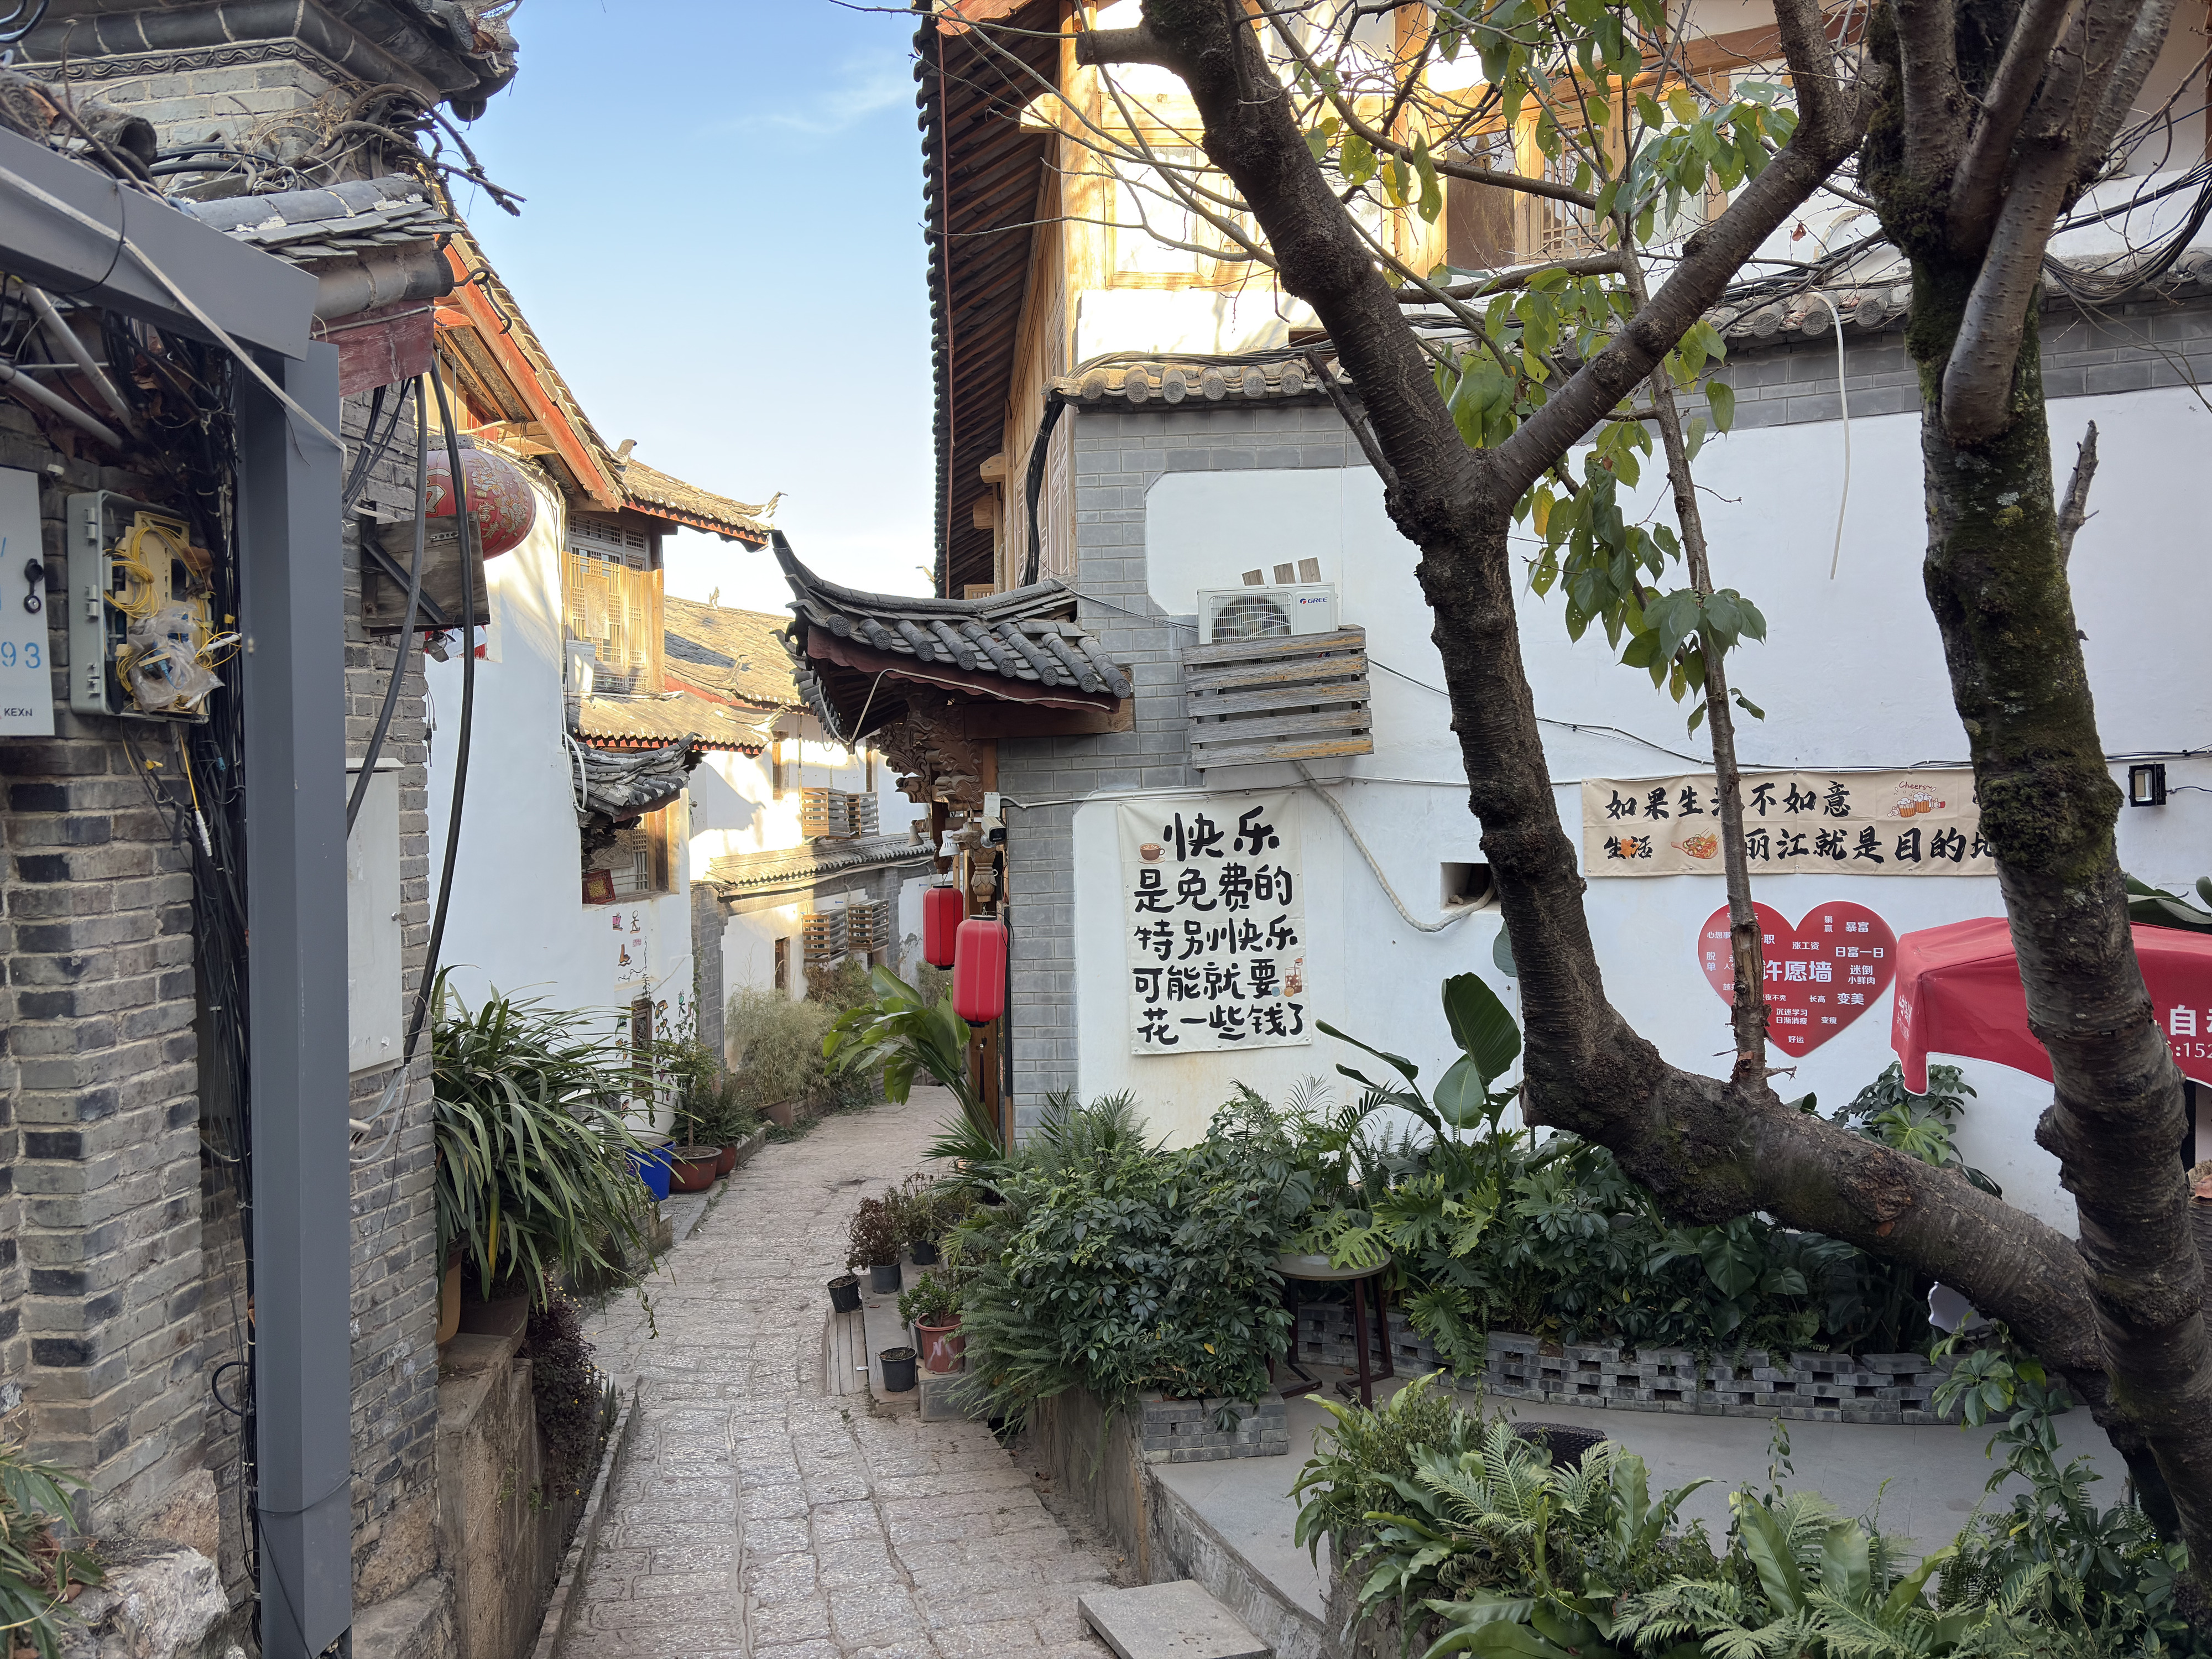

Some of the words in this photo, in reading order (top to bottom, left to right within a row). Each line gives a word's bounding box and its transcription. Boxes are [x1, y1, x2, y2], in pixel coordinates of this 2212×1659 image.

[1, 641, 41, 670] 93
[1163, 805, 1280, 862] 快乐
[1604, 835, 1653, 860] 生活
[1133, 862, 1292, 913] 是免费的
[1824, 916, 1833, 932] 躺赢
[1845, 922, 1869, 932] 暴富
[1133, 914, 1298, 961] 特别快乐
[1761, 935, 1775, 945] 职
[1792, 941, 1819, 950] 涨工资
[1835, 947, 1884, 958] 日富一日
[1706, 951, 1716, 972] 脱单
[1762, 960, 1832, 983] 许愿墙
[1850, 965, 1873, 975] 迷倒
[1133, 959, 1281, 1004] 可能就要
[1848, 976, 1875, 985] 小鲜肉
[1809, 995, 1825, 1003] 长高
[1837, 993, 1864, 1005] 变美
[1776, 1008, 1808, 1016] 沉迷学习
[1137, 1001, 1303, 1045] 花一些钱了
[1776, 1017, 1807, 1025] 日渐消瘦
[1821, 1016, 1837, 1025] 变瘦
[2170, 1004, 2212, 1037] 自
[1788, 1035, 1804, 1044] 好运
